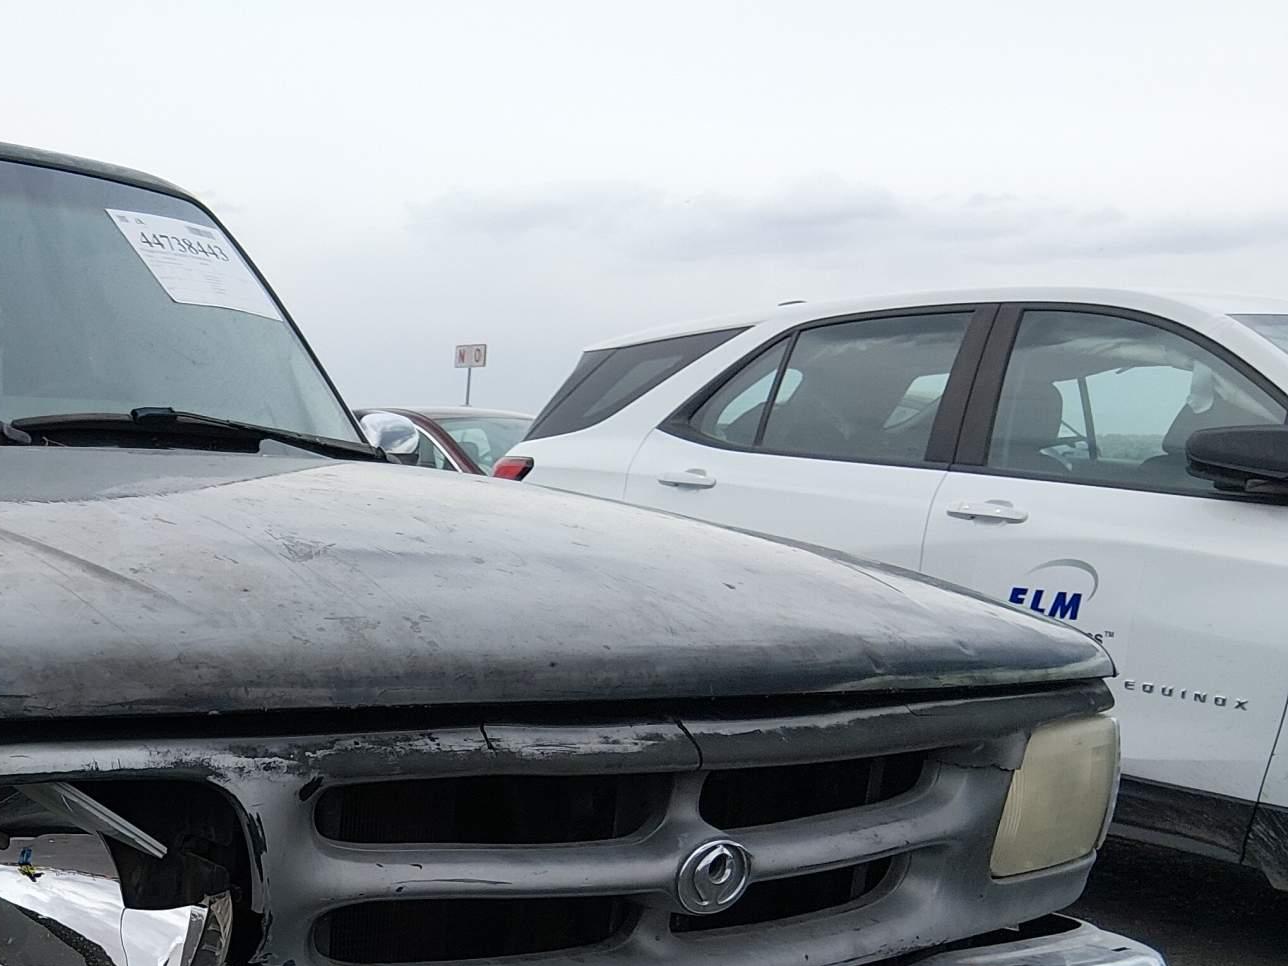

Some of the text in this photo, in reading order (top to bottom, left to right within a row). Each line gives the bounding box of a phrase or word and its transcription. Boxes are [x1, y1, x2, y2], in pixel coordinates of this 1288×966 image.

[139, 231, 230, 262] 44738443
[1008, 587, 1083, 620] ELM
[1123, 679, 1249, 711] EQUINOX
